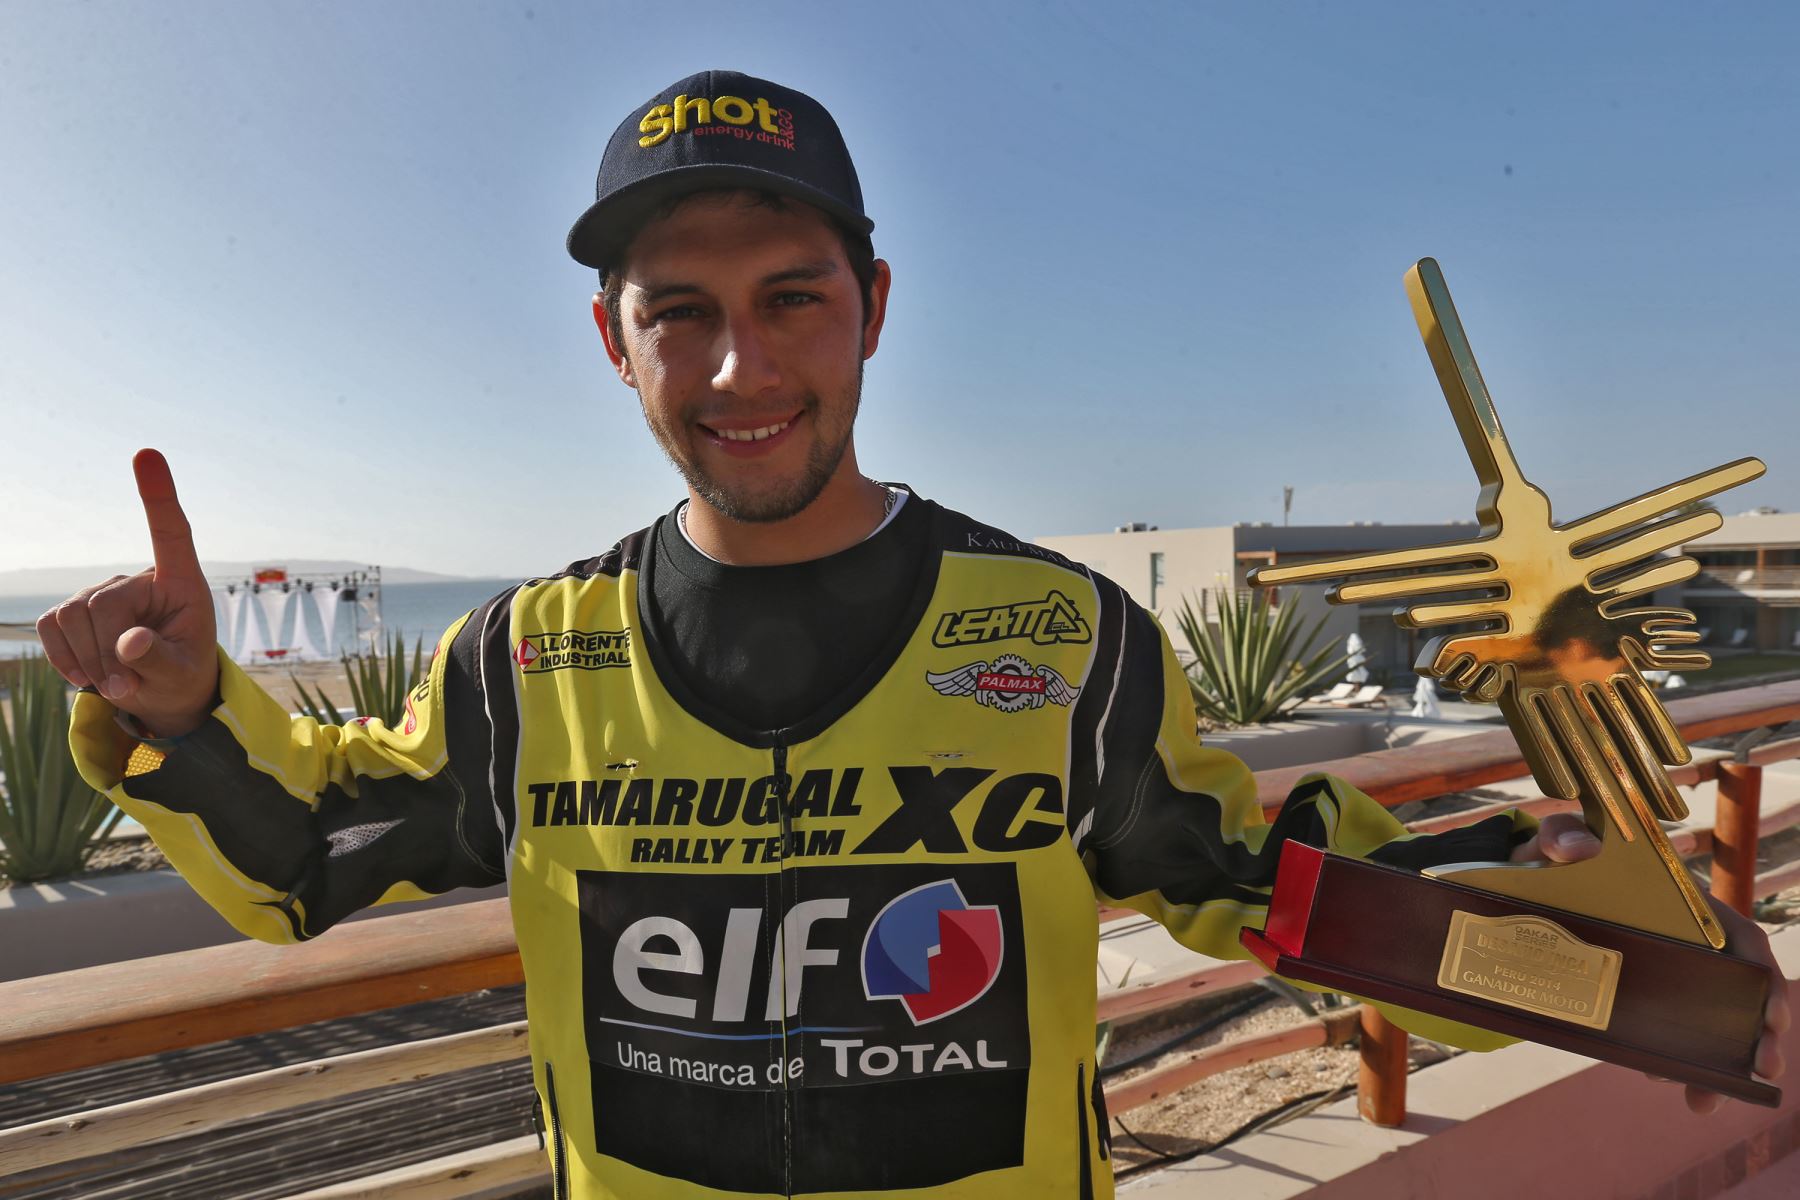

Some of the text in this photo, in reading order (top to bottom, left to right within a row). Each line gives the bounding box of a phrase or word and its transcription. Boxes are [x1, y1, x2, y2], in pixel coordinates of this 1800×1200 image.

[638, 94, 779, 149] shot
[693, 125, 796, 151] energy drink
[979, 676, 1043, 690] PALMAX
[528, 766, 1066, 855] TAMARUGAL XC
[630, 829, 845, 864] RALLY TEAM
[1514, 933, 1557, 950] SERIES
[1515, 925, 1559, 943] DAKAR
[612, 898, 850, 1022] elf
[1463, 970, 1588, 1013] GANADOR MOTO
[1529, 975, 1561, 992] 2014
[617, 1041, 663, 1074] Una
[669, 1057, 756, 1086] marca
[766, 1055, 805, 1087] de
